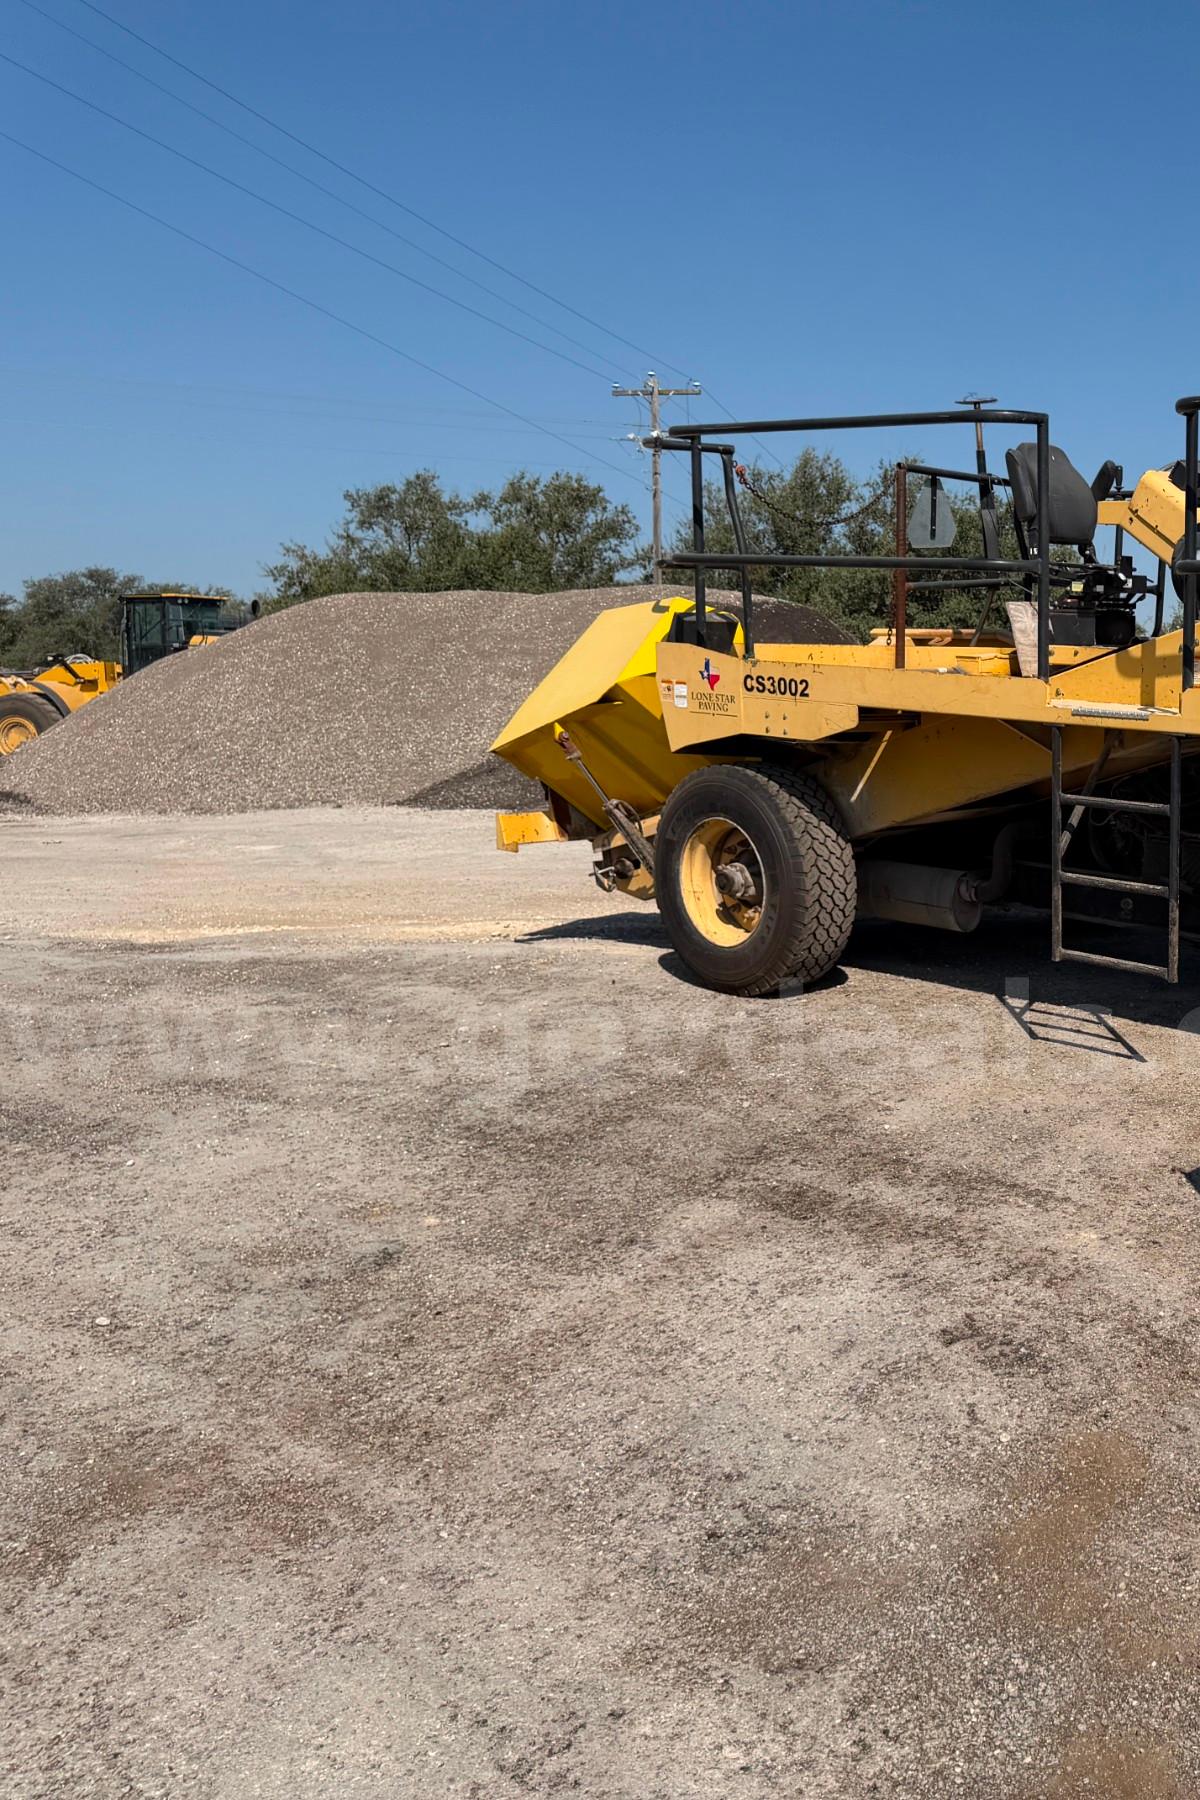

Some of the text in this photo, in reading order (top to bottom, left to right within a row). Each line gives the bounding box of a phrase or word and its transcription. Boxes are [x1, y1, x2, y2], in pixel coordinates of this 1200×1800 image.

[743, 674, 810, 698] CS3002
[691, 691, 714, 702] LONE
[715, 693, 736, 705] STAR
[698, 701, 729, 712] PAVING
